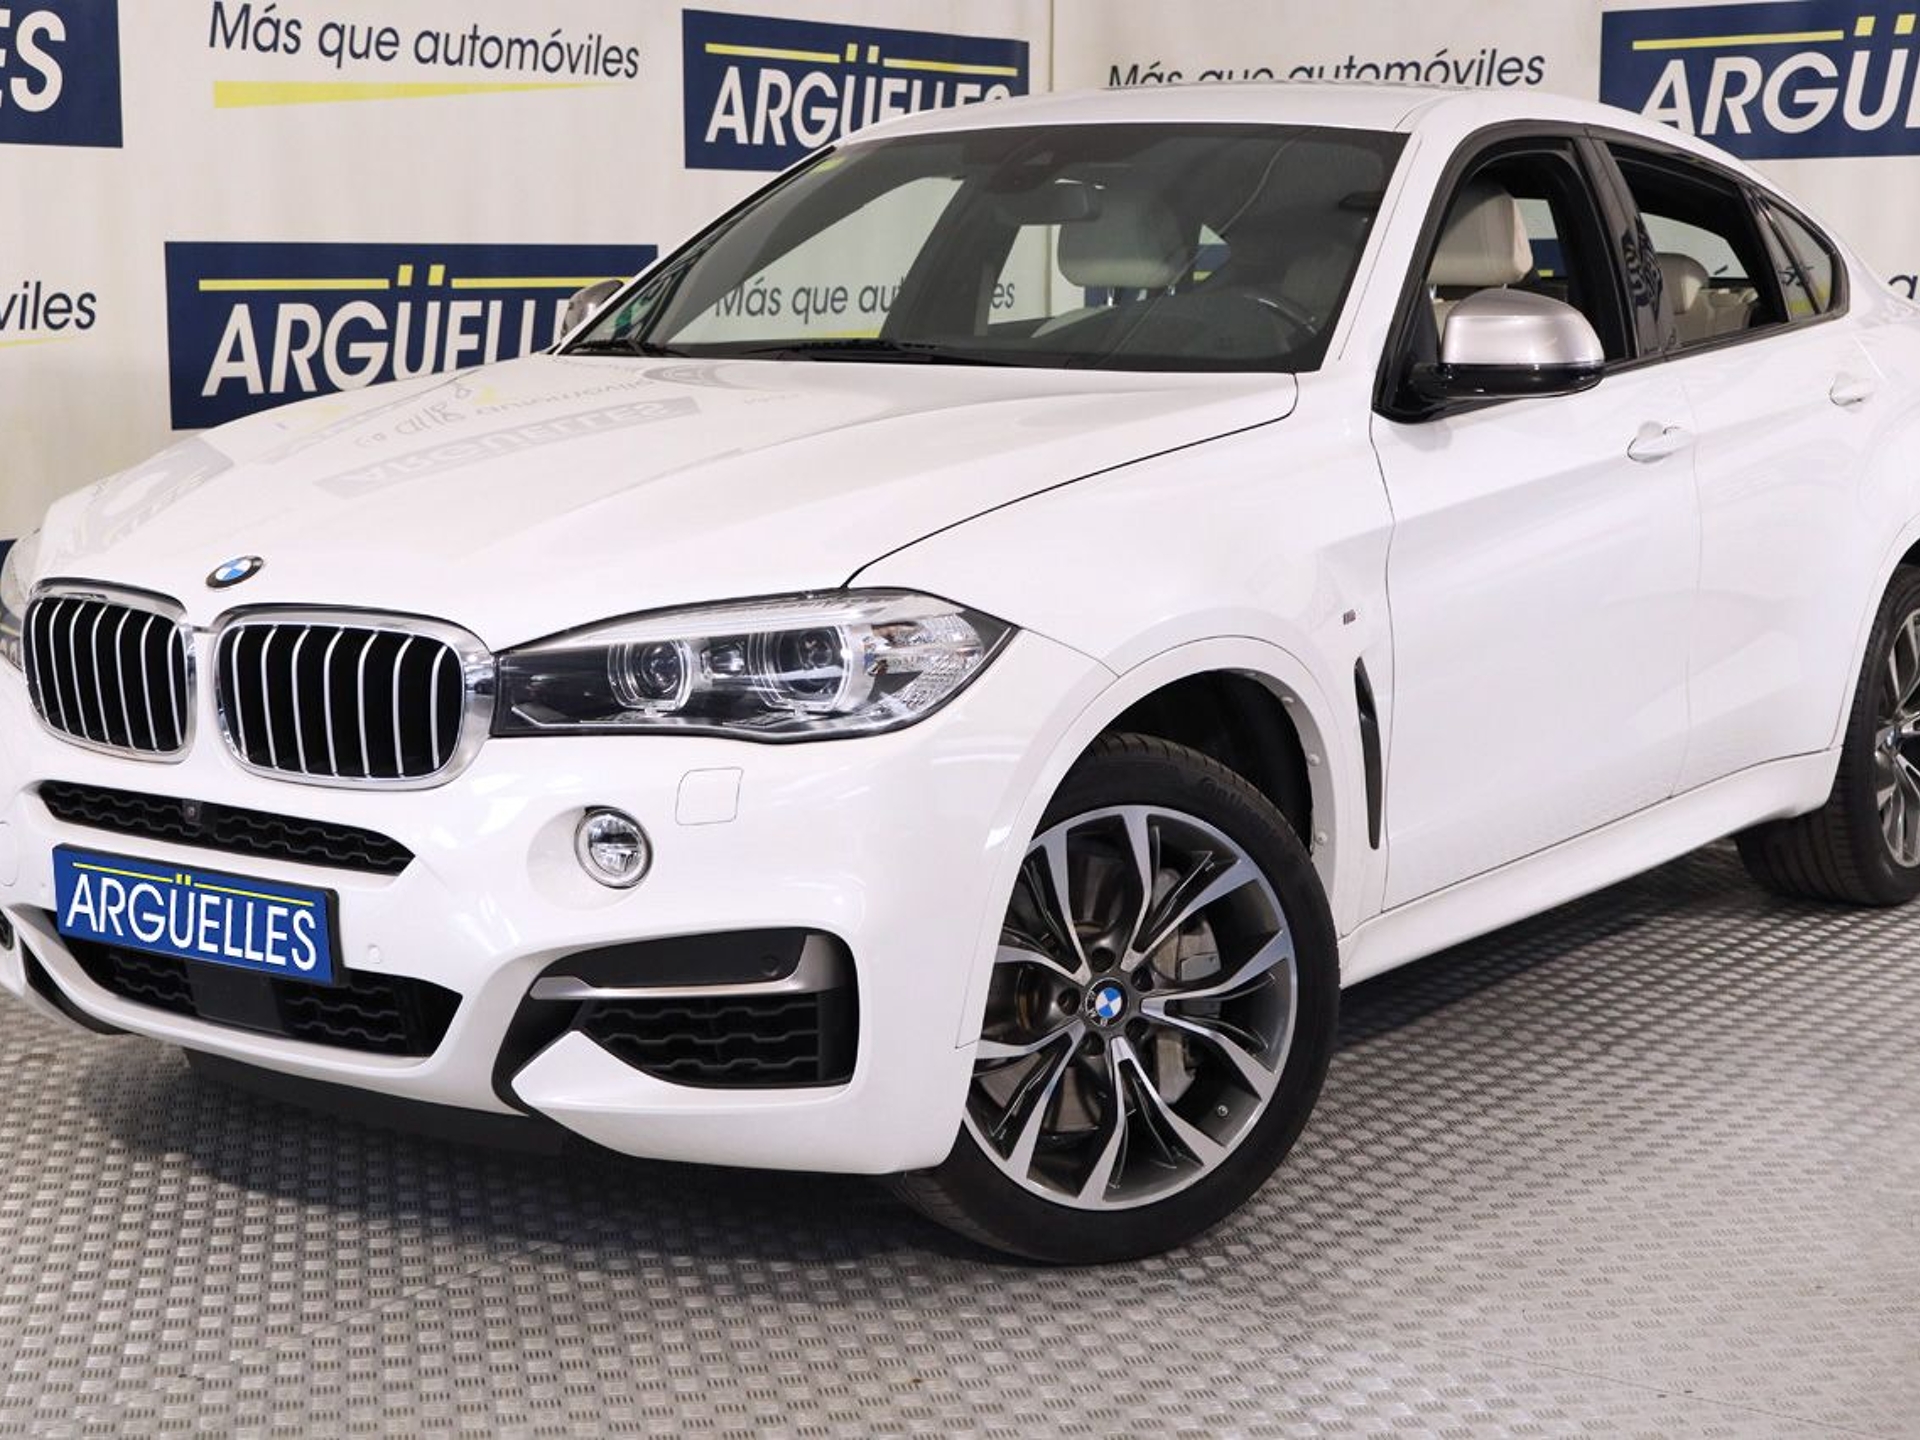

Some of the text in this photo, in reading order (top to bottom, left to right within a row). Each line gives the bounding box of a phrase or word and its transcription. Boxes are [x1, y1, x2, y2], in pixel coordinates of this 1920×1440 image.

[208, 1, 639, 78] Más que automóviles
[792, 283, 849, 325] que
[66, 873, 317, 971] ARGÜELLES
